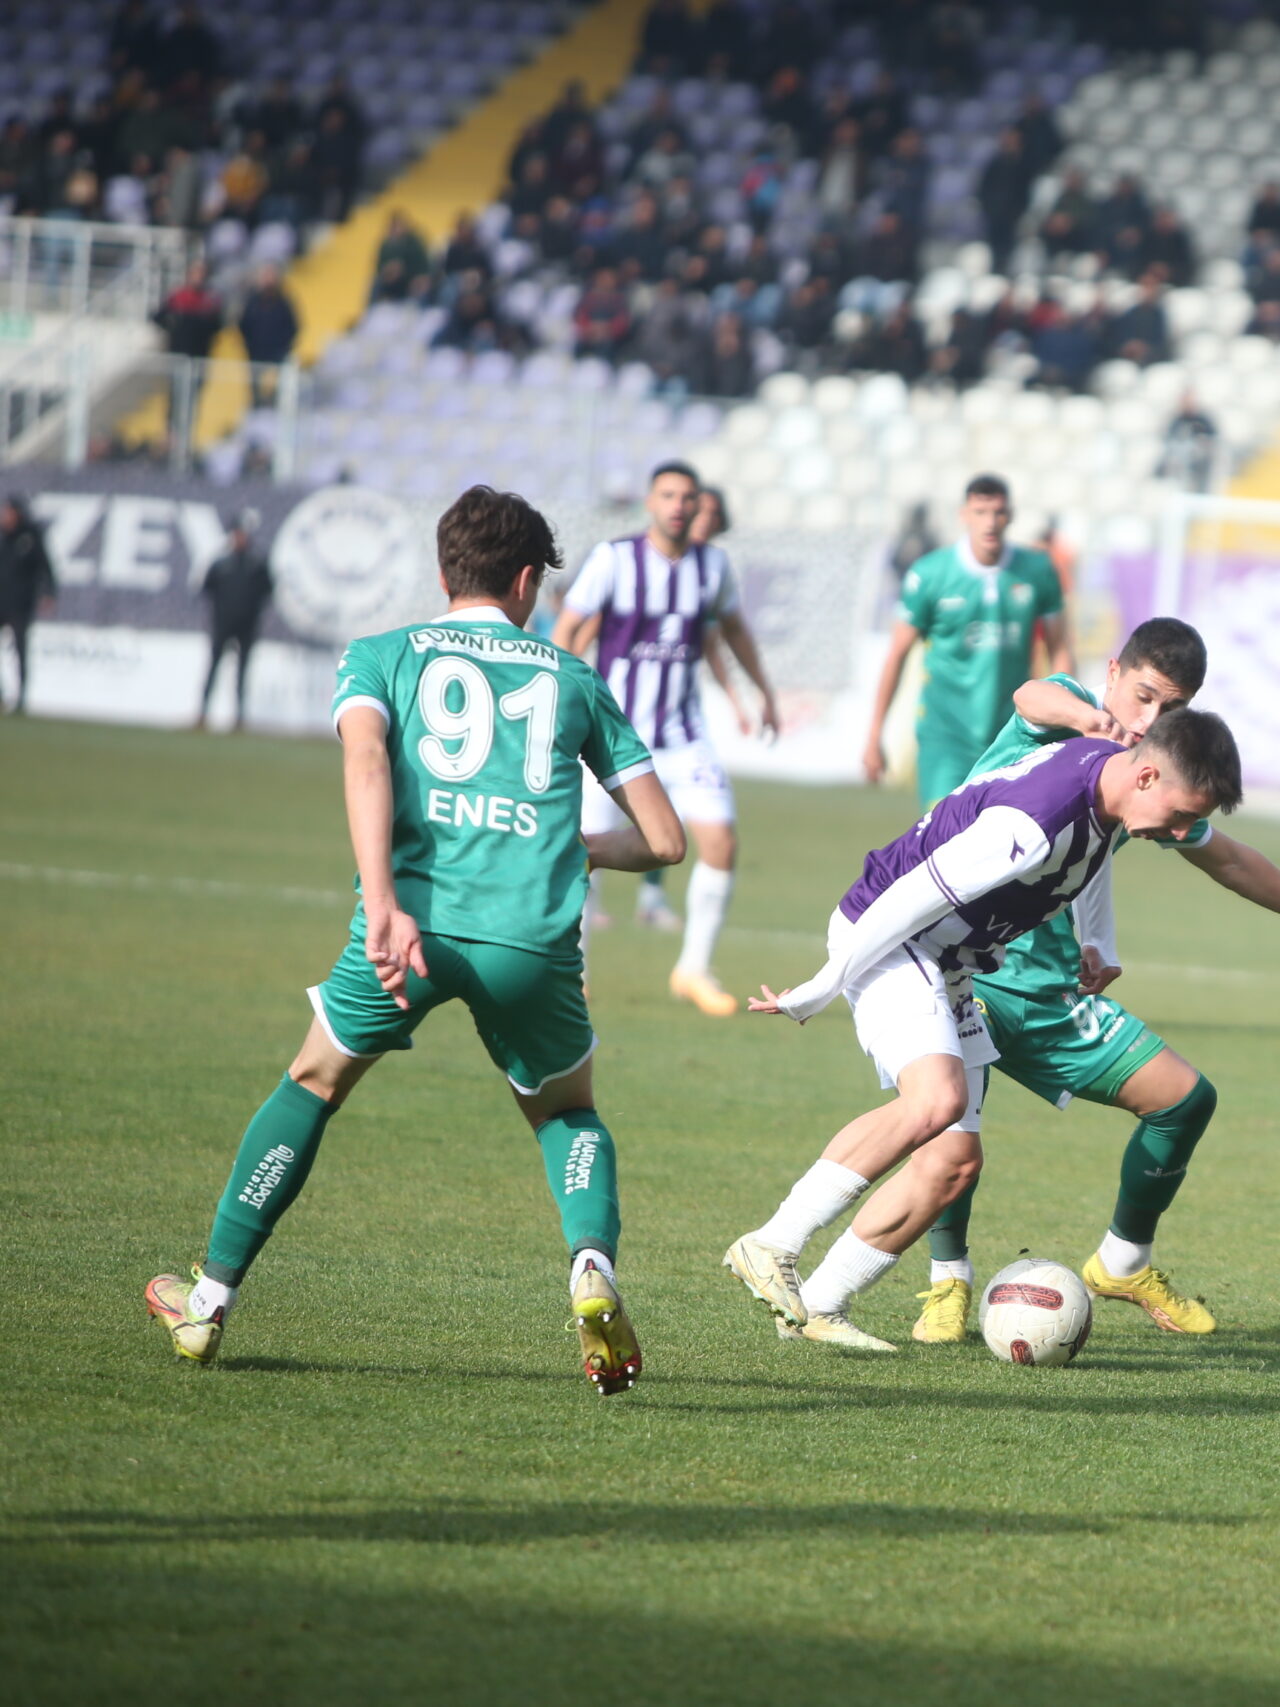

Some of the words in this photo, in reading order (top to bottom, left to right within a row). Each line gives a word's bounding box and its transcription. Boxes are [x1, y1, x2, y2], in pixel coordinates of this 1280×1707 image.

[412, 629, 556, 661] DOWNTOWN
[418, 656, 559, 793] 91
[427, 788, 538, 838] ENES
[248, 1159, 287, 1210] AHTAPOT
